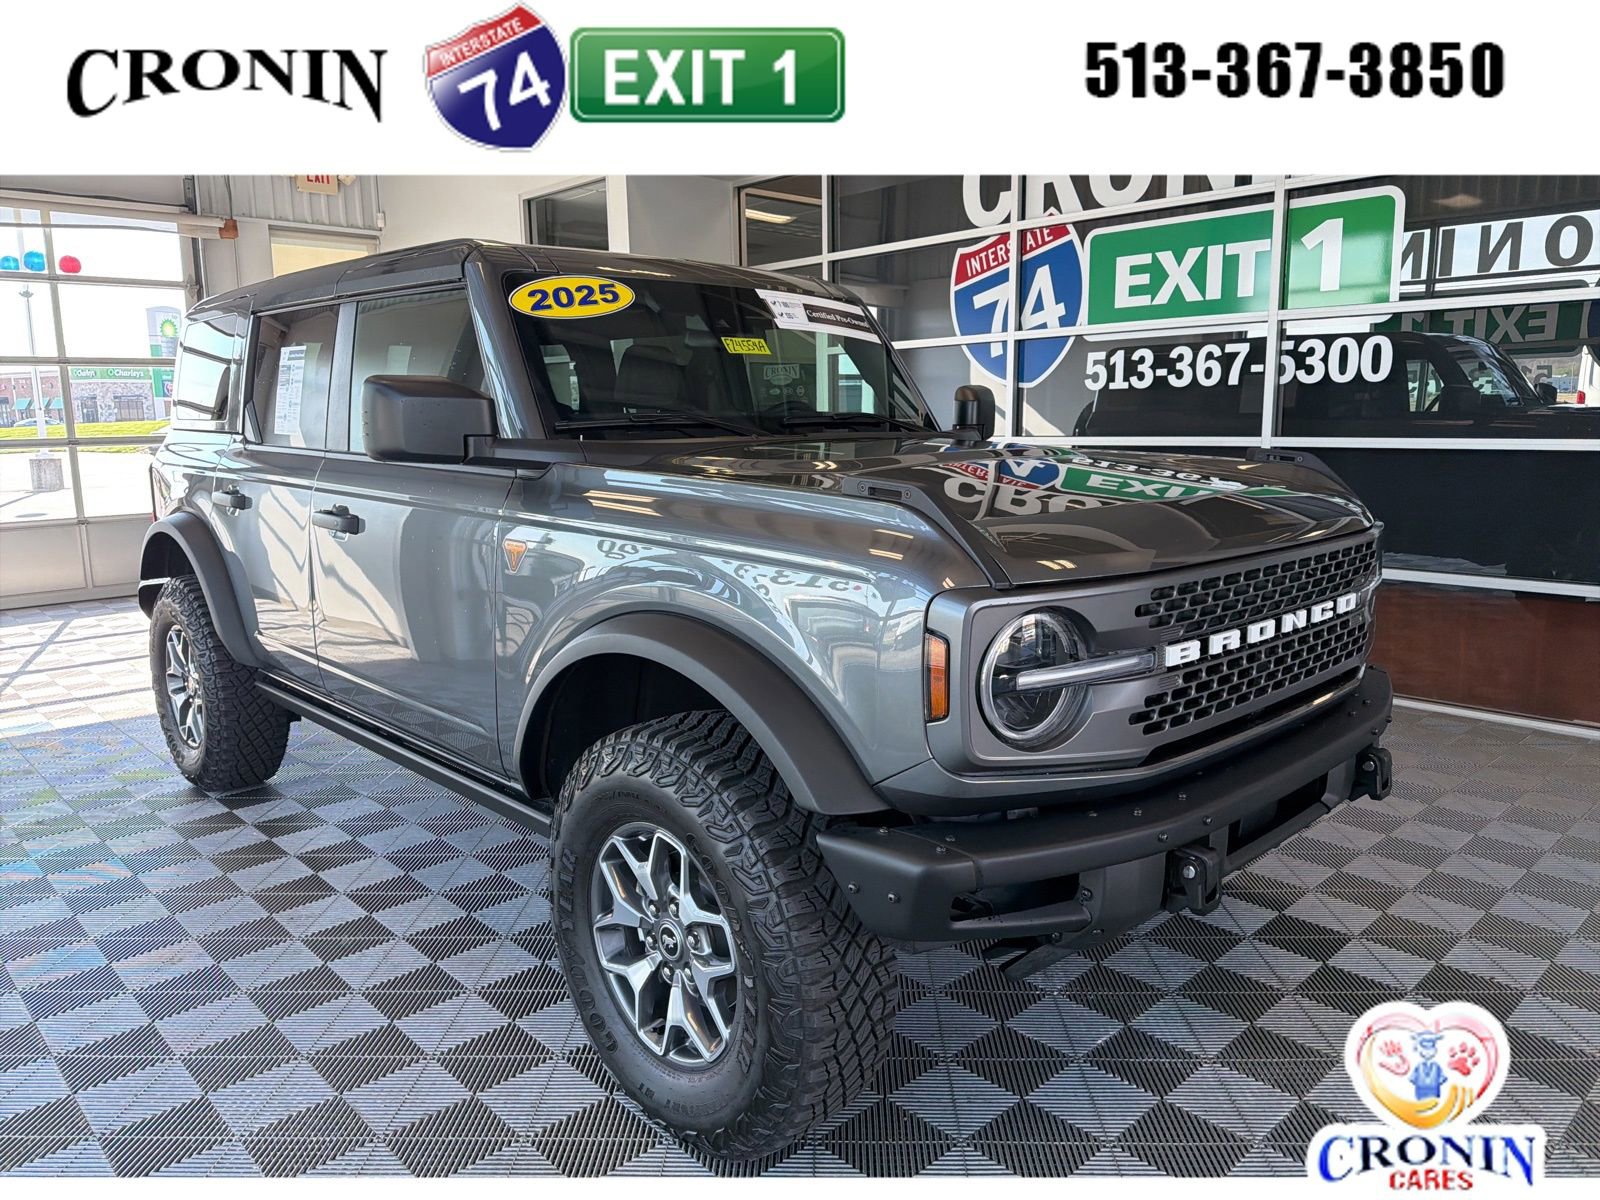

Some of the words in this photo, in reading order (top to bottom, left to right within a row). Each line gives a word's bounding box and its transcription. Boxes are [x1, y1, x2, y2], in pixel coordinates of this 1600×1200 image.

[1114, 238, 1272, 309] EXIT
[1301, 217, 1344, 292] 1
[527, 283, 620, 312] 2025
[806, 309, 836, 321] Certified
[972, 264, 1067, 358] 74
[1084, 335, 1394, 391] 513-367-5300
[1165, 592, 1357, 667] BRONCO
